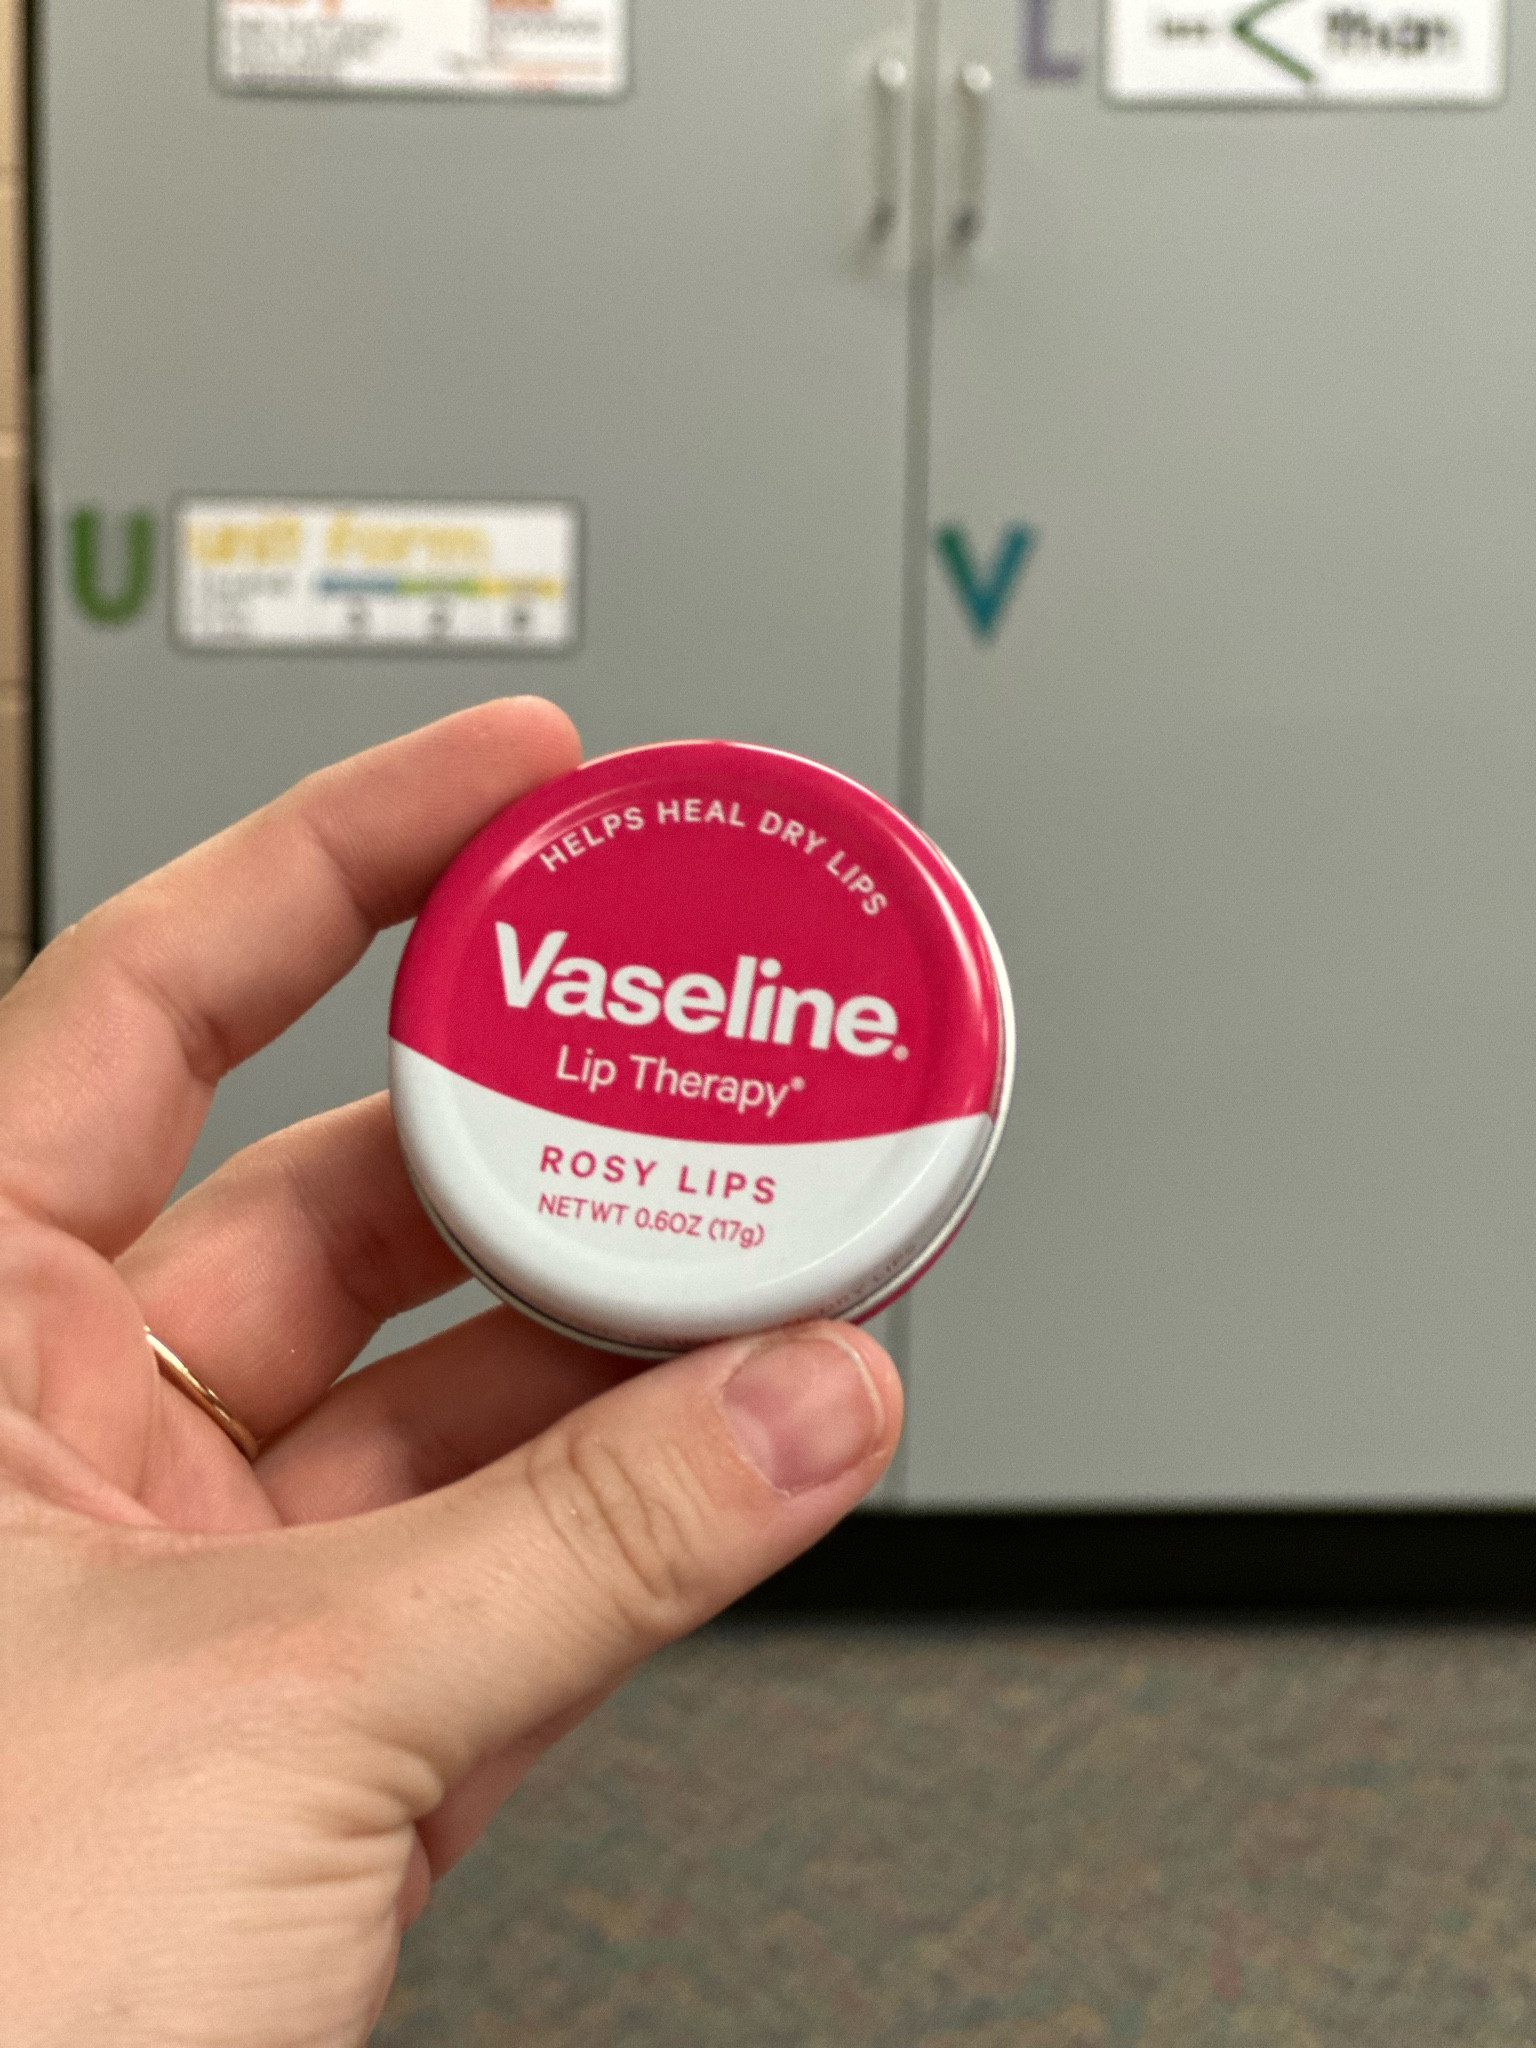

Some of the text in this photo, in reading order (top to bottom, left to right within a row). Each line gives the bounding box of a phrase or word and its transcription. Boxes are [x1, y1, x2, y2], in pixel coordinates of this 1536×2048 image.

[70, 508, 155, 626] U
[937, 522, 1036, 640] V
[540, 798, 888, 917] HELPS HEAL DRY LIPS
[556, 1044, 618, 1094] Lip
[540, 1144, 777, 1205] ROSY LIPS
[708, 1218, 766, 1249] (17g)
